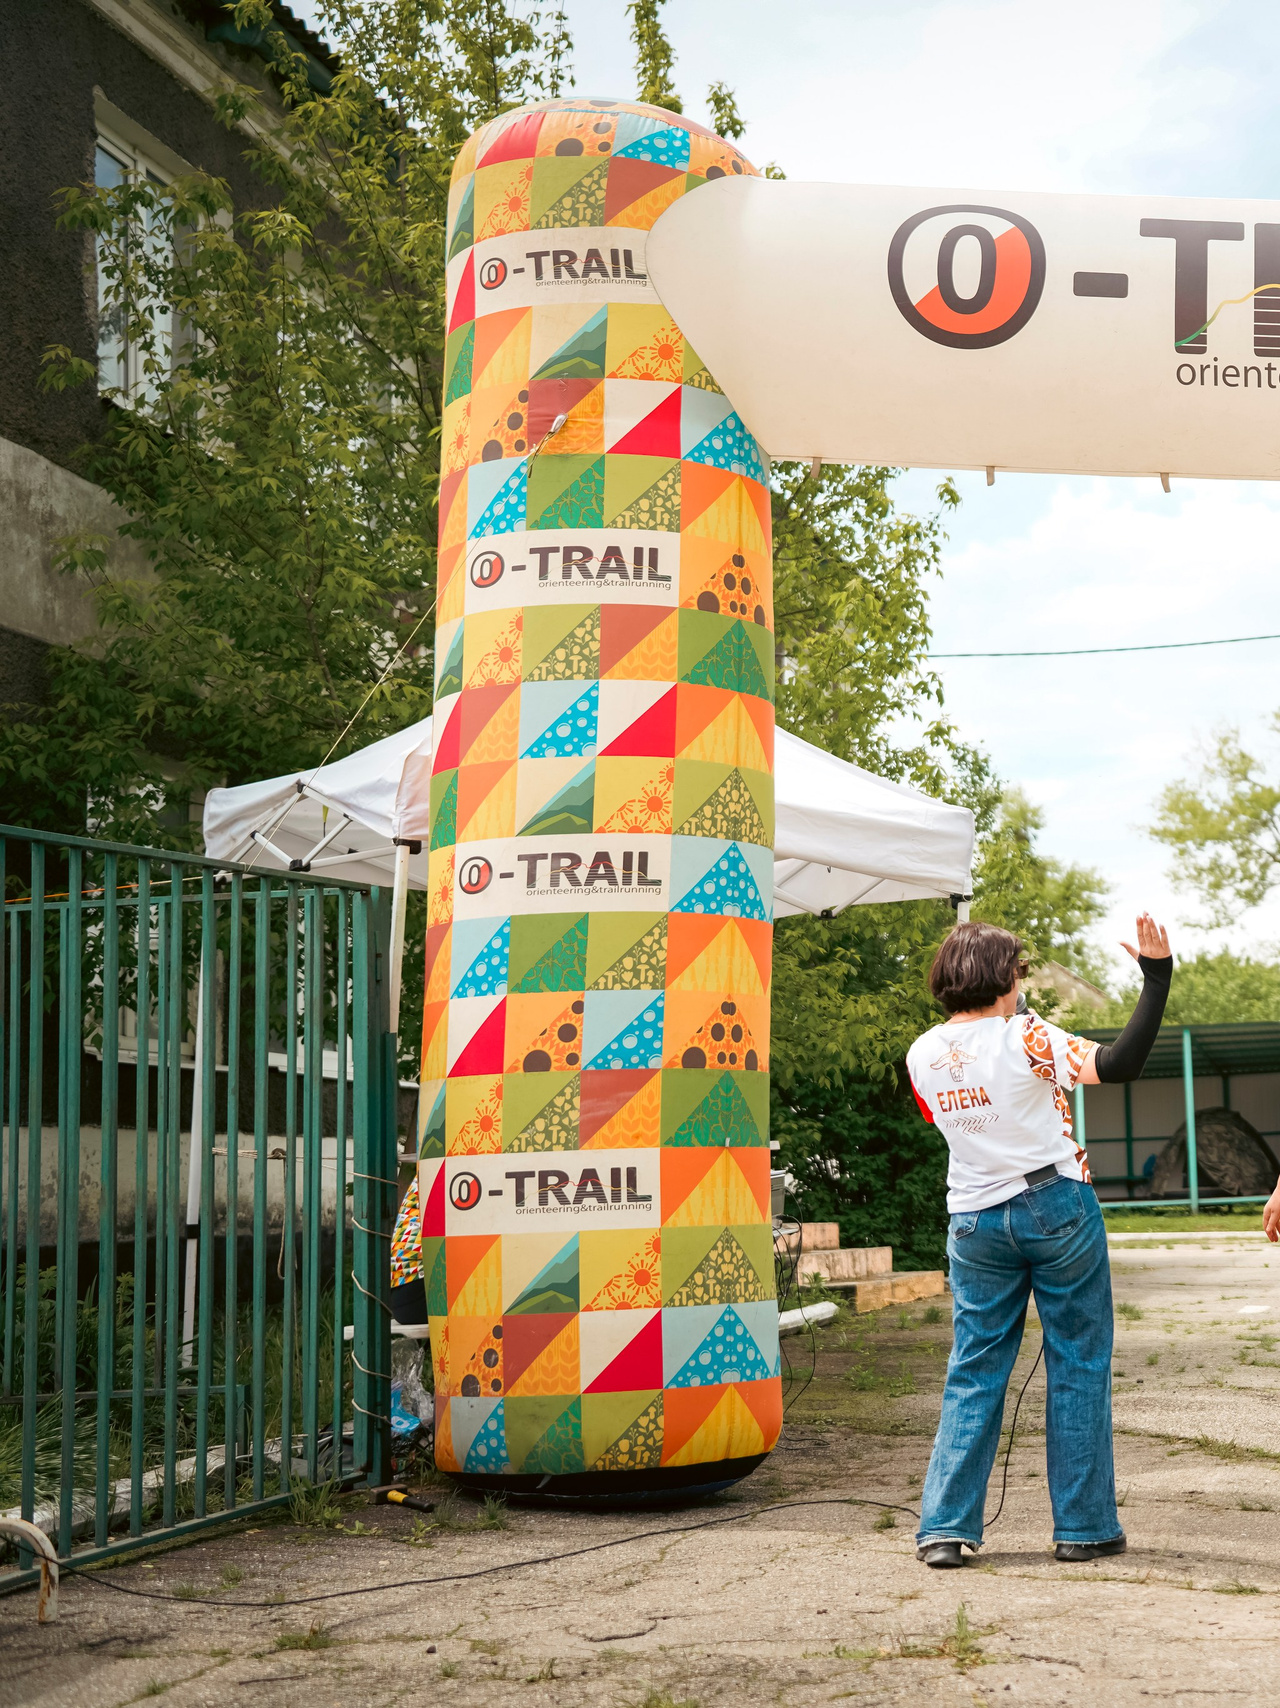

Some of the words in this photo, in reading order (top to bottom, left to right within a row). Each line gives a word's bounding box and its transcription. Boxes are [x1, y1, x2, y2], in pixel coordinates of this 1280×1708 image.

[535, 277, 648, 288] orienteering&trailrunning
[538, 579, 672, 591] orienteering&trailrunning
[526, 885, 662, 896] orienteering&trailrunning
[936, 1086, 993, 1113] ЕЛЕНА
[515, 1202, 653, 1214] orienteering&trailrunning
